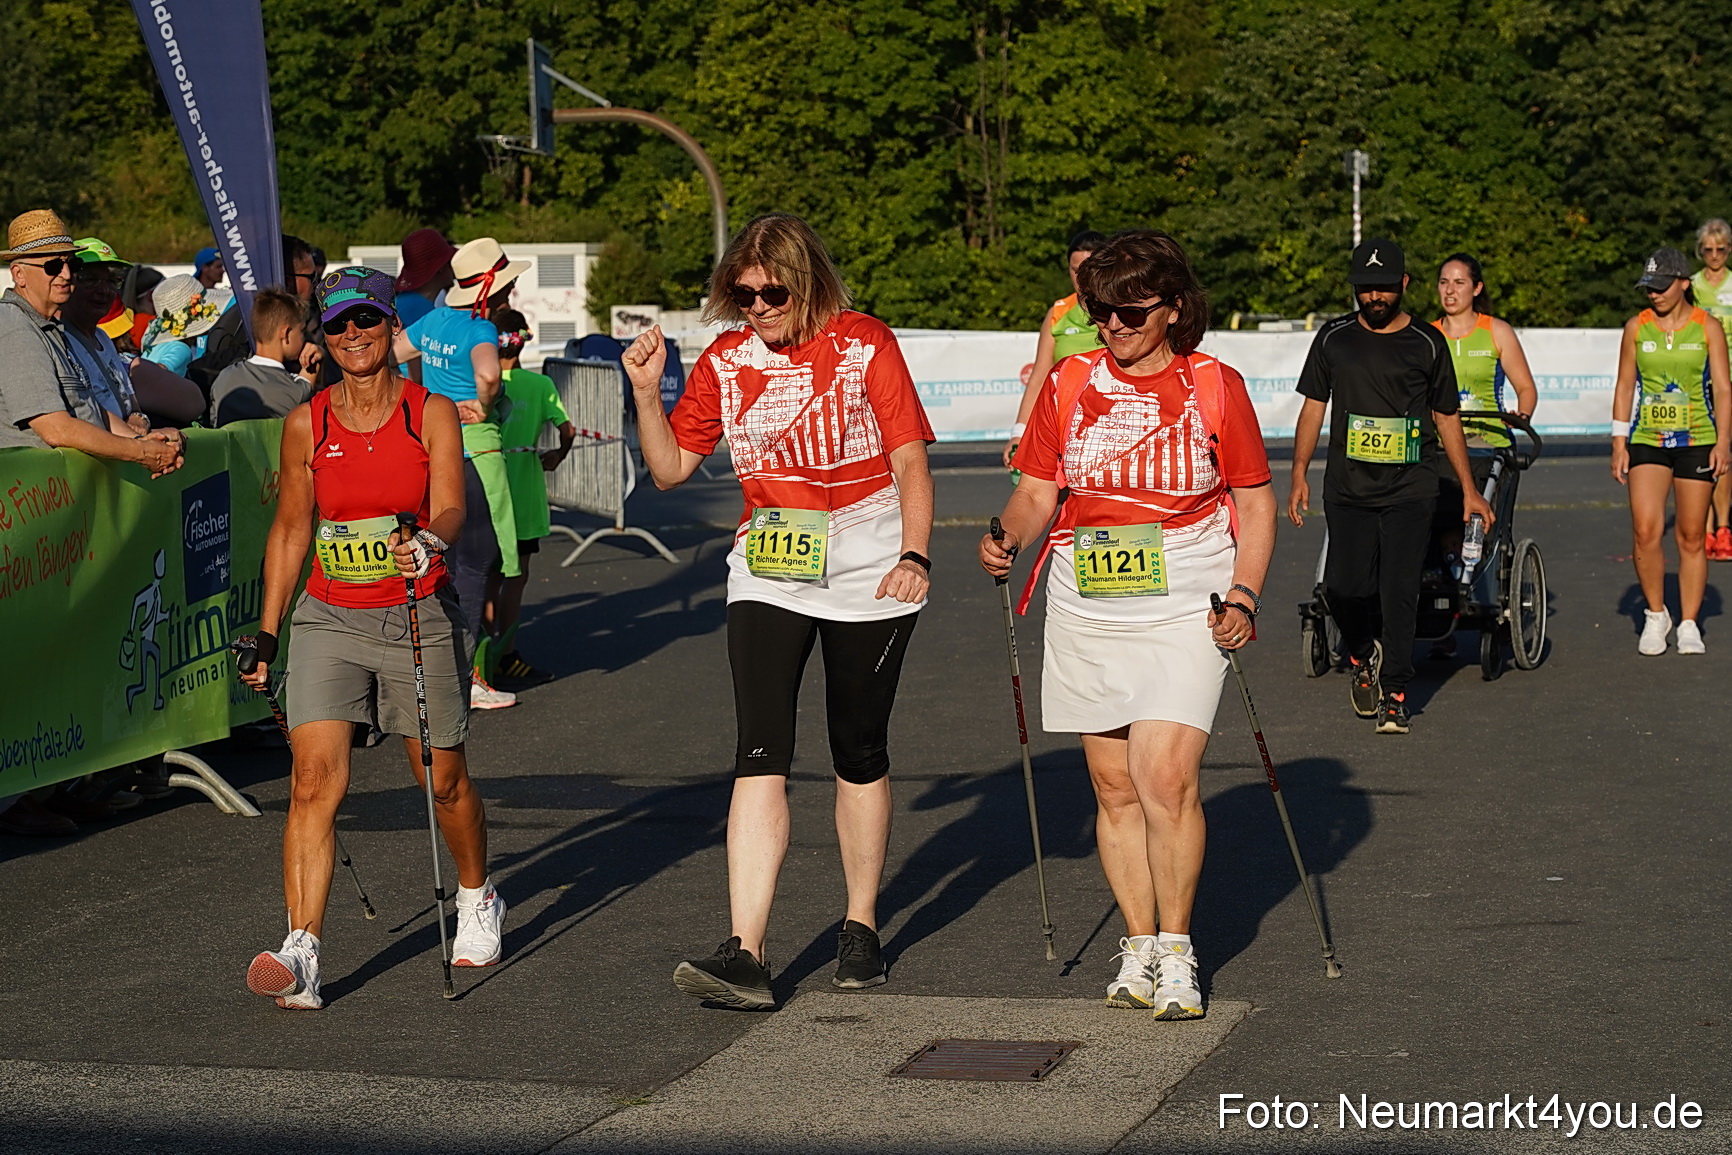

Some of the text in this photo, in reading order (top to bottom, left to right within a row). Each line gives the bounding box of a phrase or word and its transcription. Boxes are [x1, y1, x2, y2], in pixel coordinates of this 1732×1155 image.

[935, 379, 1022, 395] FAHRRÄDER
[1256, 378, 1296, 392] FAHR
[1651, 406, 1677, 419] 608
[1361, 432, 1392, 448] 267
[8, 476, 75, 525] Firmen
[190, 512, 229, 543] Fischer
[36, 510, 94, 587] länger!
[194, 531, 229, 552] AUTOMOBILE
[329, 541, 388, 563] 1110
[748, 533, 757, 567] WALK
[758, 531, 811, 556] 1115
[811, 538, 822, 570] 2022
[319, 543, 332, 572] WALK
[335, 563, 388, 572] Bezold Ulrike
[755, 555, 808, 567] Richter Agnes
[1087, 549, 1146, 574] 1121
[1150, 551, 1162, 584] 2022
[1078, 554, 1088, 588] WALK
[1087, 573, 1152, 583] Naumann Hildegard
